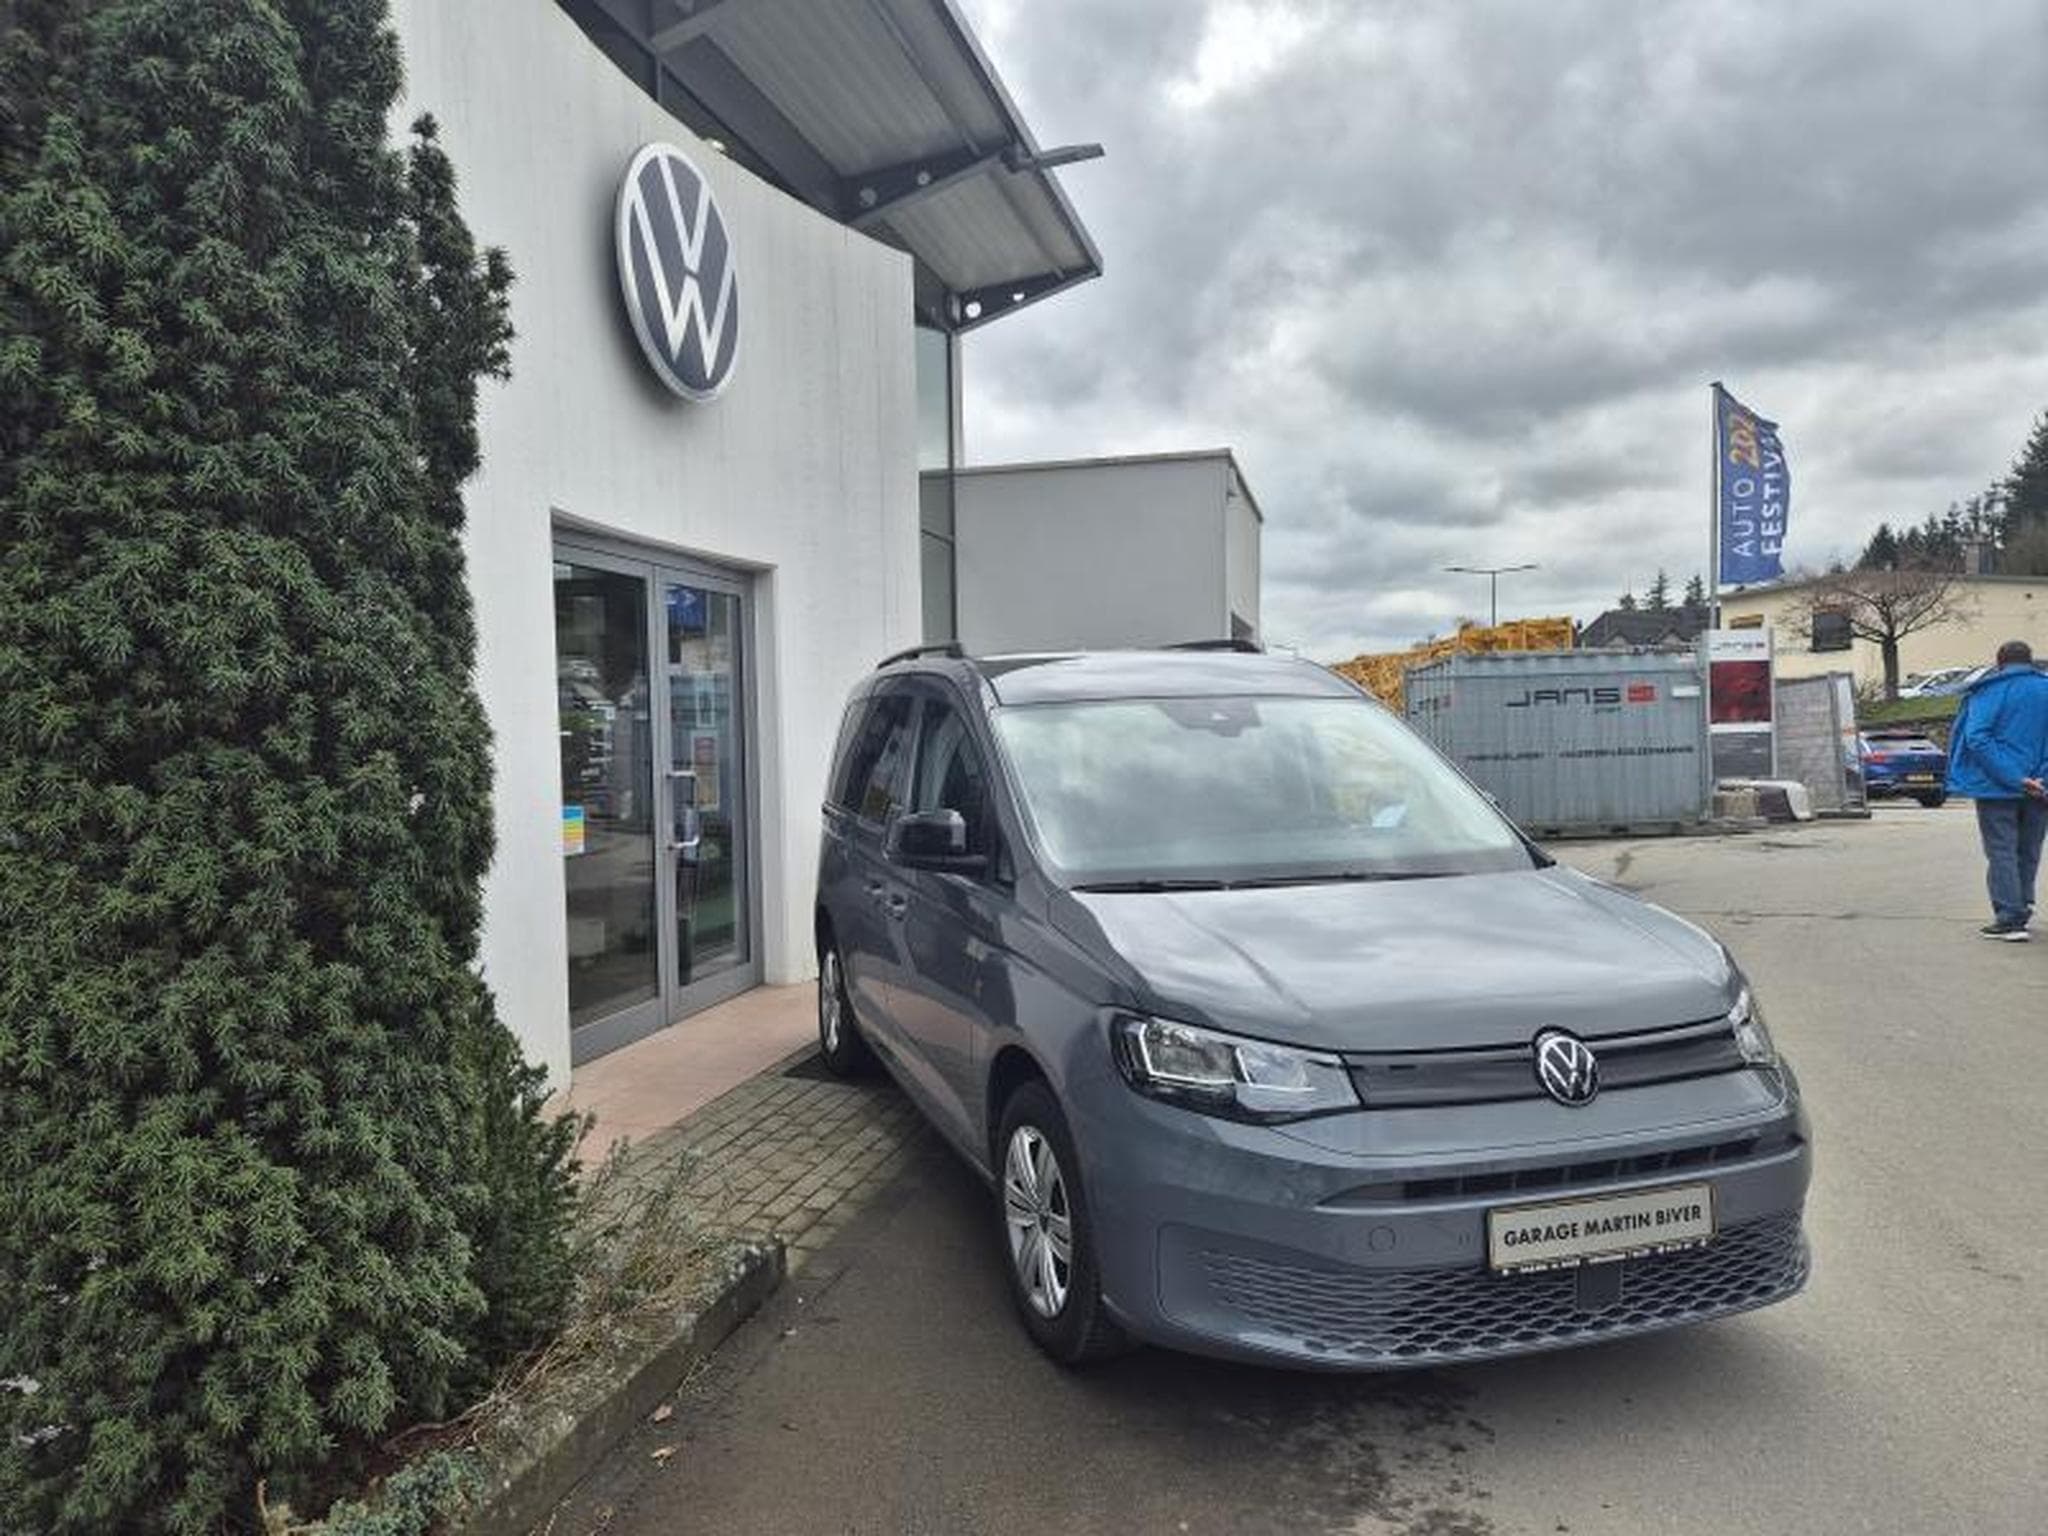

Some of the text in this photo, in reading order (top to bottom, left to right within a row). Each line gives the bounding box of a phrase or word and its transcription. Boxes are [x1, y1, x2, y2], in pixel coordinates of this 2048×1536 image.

[626, 151, 737, 389] VW
[1731, 478, 1756, 557] AUTO
[1760, 432, 1784, 555] FESTIV
[1503, 1204, 1702, 1247] GARAGE MARTIN BIVER
